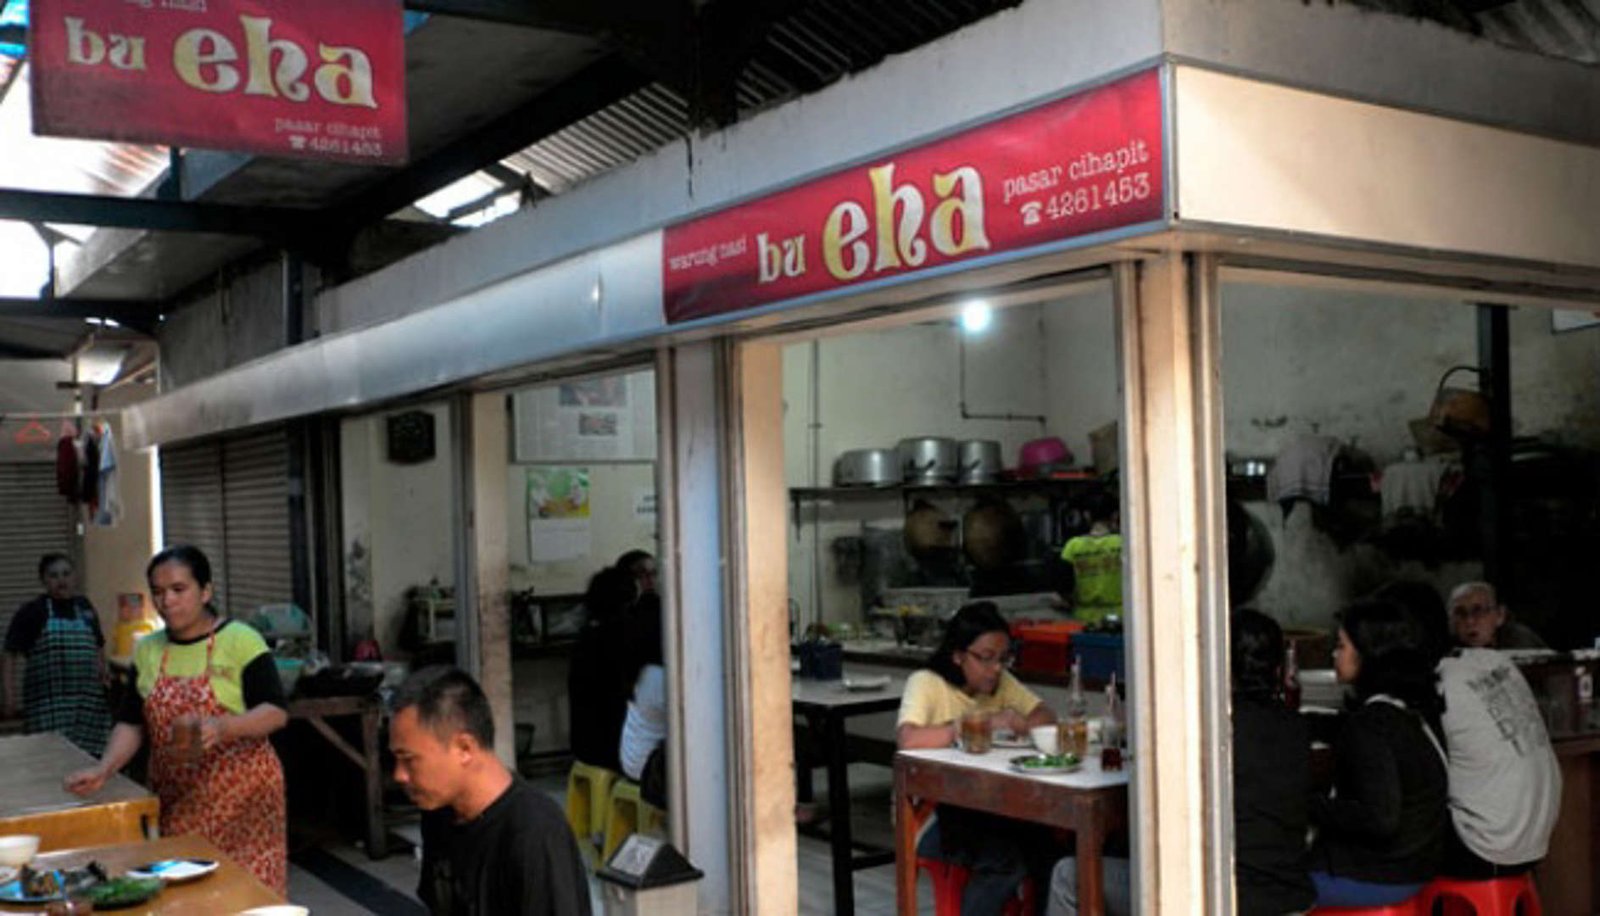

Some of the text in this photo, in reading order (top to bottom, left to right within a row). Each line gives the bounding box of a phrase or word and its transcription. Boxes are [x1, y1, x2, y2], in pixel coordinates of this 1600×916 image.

[64, 14, 378, 108] bu eha
[1004, 139, 1148, 204] pasar cihapit
[1046, 172, 1151, 220] 4261453
[669, 234, 747, 271] warung nasi
[756, 162, 991, 284] bu eha
